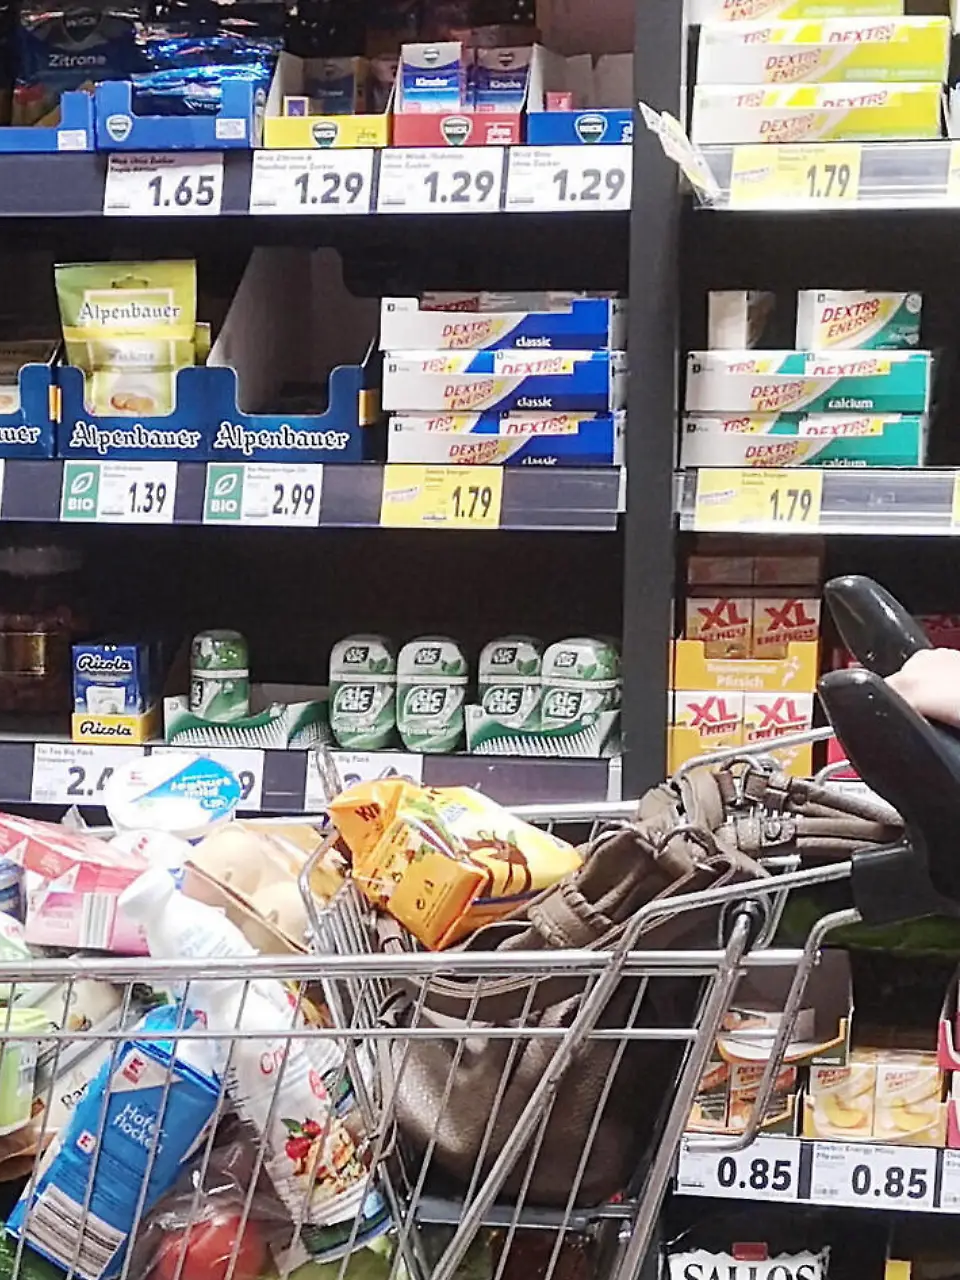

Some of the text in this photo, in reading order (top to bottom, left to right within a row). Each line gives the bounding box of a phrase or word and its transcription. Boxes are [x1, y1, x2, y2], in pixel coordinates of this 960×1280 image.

[48, 53, 107, 68] Zitrone
[147, 175, 216, 206] 1.65
[294, 172, 365, 204] 1.29
[423, 170, 495, 203] 1.29
[552, 168, 626, 202] 1.29
[806, 163, 851, 198] 1.79
[80, 301, 181, 325] Alpenbauer
[819, 298, 880, 323] DEXTRO
[442, 318, 493, 337] DEXTRO
[826, 311, 879, 338] ENERGY
[515, 336, 552, 348] classic
[444, 379, 494, 398] DEXTRO
[750, 379, 806, 399] DEXTRO
[516, 395, 553, 408] classic
[827, 397, 874, 409] calcium
[70, 421, 202, 454] Alpenbauer
[213, 422, 351, 456] Alpenbauer
[449, 439, 499, 458] DEXTRO
[744, 440, 800, 459] DEXTRO
[67, 498, 94, 511] BIO
[128, 481, 167, 513] 1.39
[210, 500, 237, 513] BIO
[272, 483, 316, 515] 2.99
[452, 485, 492, 519] 1.79
[769, 489, 813, 522] 1.79
[696, 598, 750, 632] XL
[764, 598, 817, 632] XL
[77, 652, 132, 671] Ricola
[344, 686, 372, 701] tic
[414, 688, 445, 701] tic
[491, 688, 524, 702] tic
[551, 691, 580, 705] tic
[341, 699, 371, 713] tac
[411, 700, 443, 714] tac
[487, 700, 521, 714] tac
[547, 702, 577, 717] tac
[686, 695, 738, 727] XL
[755, 696, 807, 728] XL
[79, 720, 133, 737] Ricola
[717, 1156, 792, 1191] 0.85
[851, 1164, 928, 1199] 0.85
